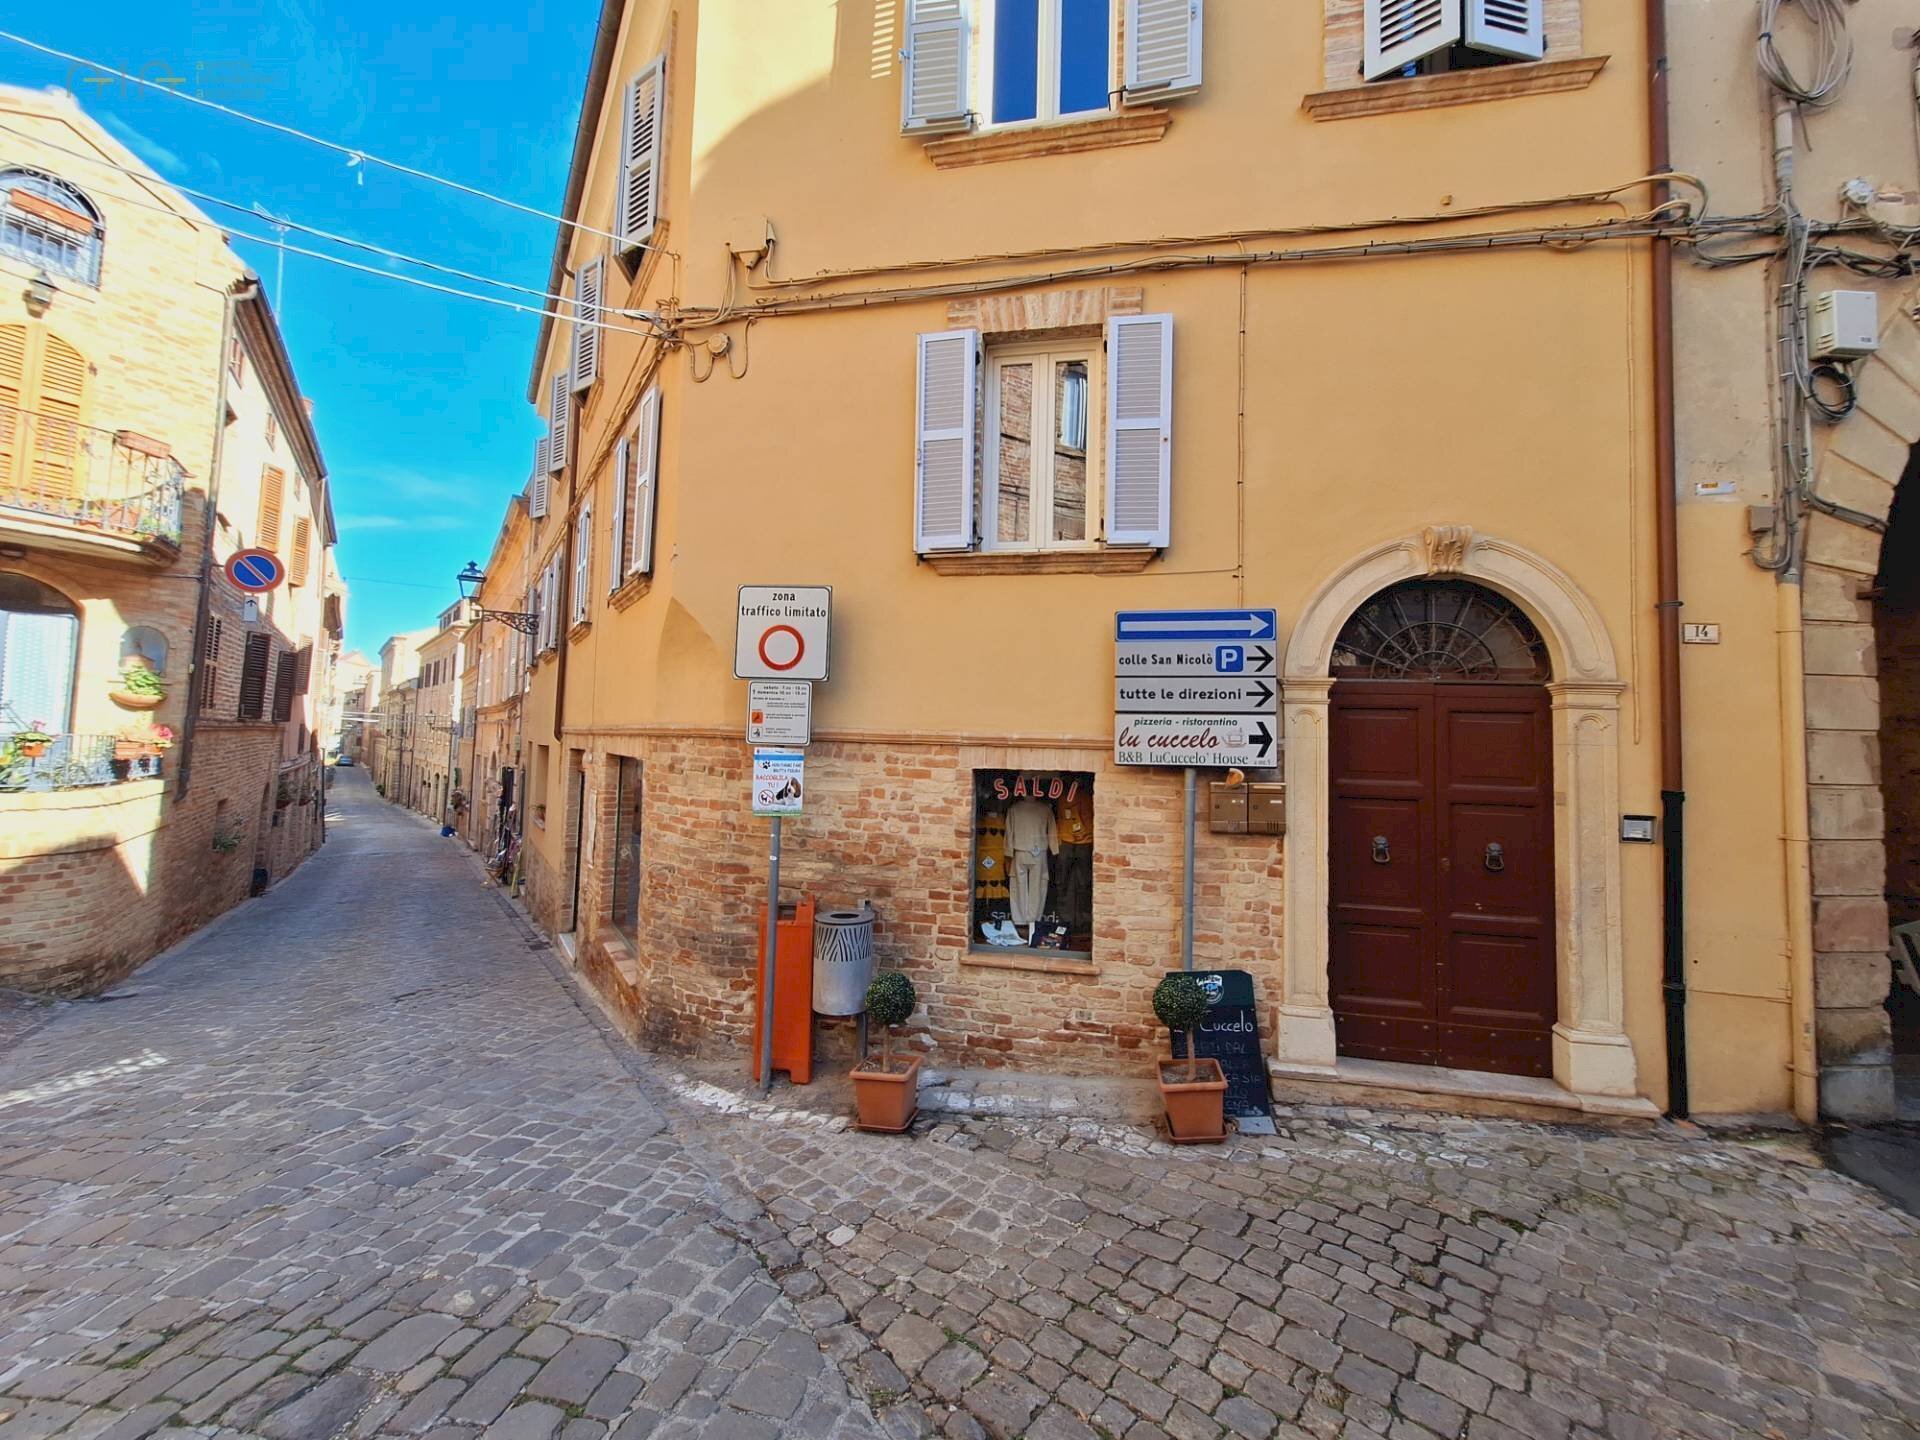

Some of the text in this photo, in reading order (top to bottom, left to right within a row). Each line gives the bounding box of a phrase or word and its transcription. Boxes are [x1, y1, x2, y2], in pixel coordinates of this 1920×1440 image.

[772, 592, 796, 601] zona
[741, 605, 827, 618] traffico limitato
[1694, 625, 1708, 637] 14
[1119, 648, 1237, 670] colle San Nicolò P
[1120, 688, 1242, 700] tutte le direzioni
[1134, 717, 1172, 727] pizzeria
[1182, 717, 1238, 727] ristorantino
[1118, 727, 1220, 749] lu cuccelo
[1118, 751, 1143, 763] B&B
[1213, 753, 1248, 765] House
[994, 776, 1078, 802] SALDI
